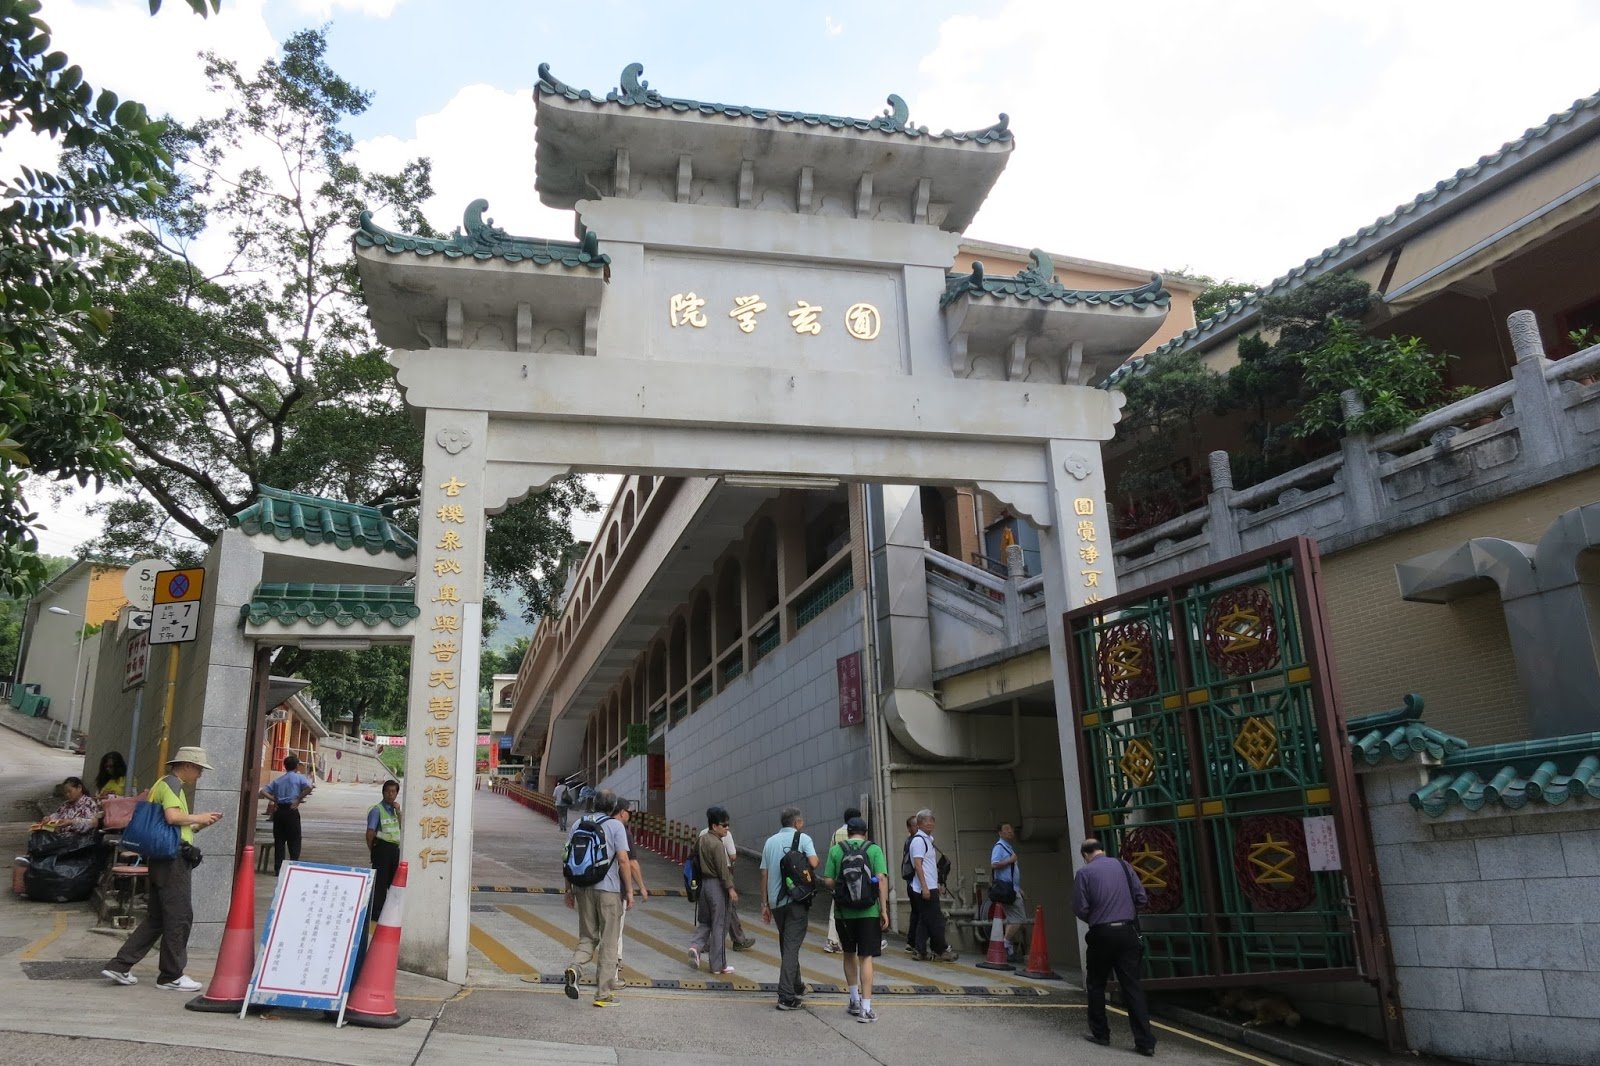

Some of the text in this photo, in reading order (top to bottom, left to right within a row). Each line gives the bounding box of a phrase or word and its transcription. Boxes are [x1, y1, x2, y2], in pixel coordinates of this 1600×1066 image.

[160, 611, 175, 620] 上午
[184, 604, 191, 618] 7
[181, 625, 189, 639] 7
